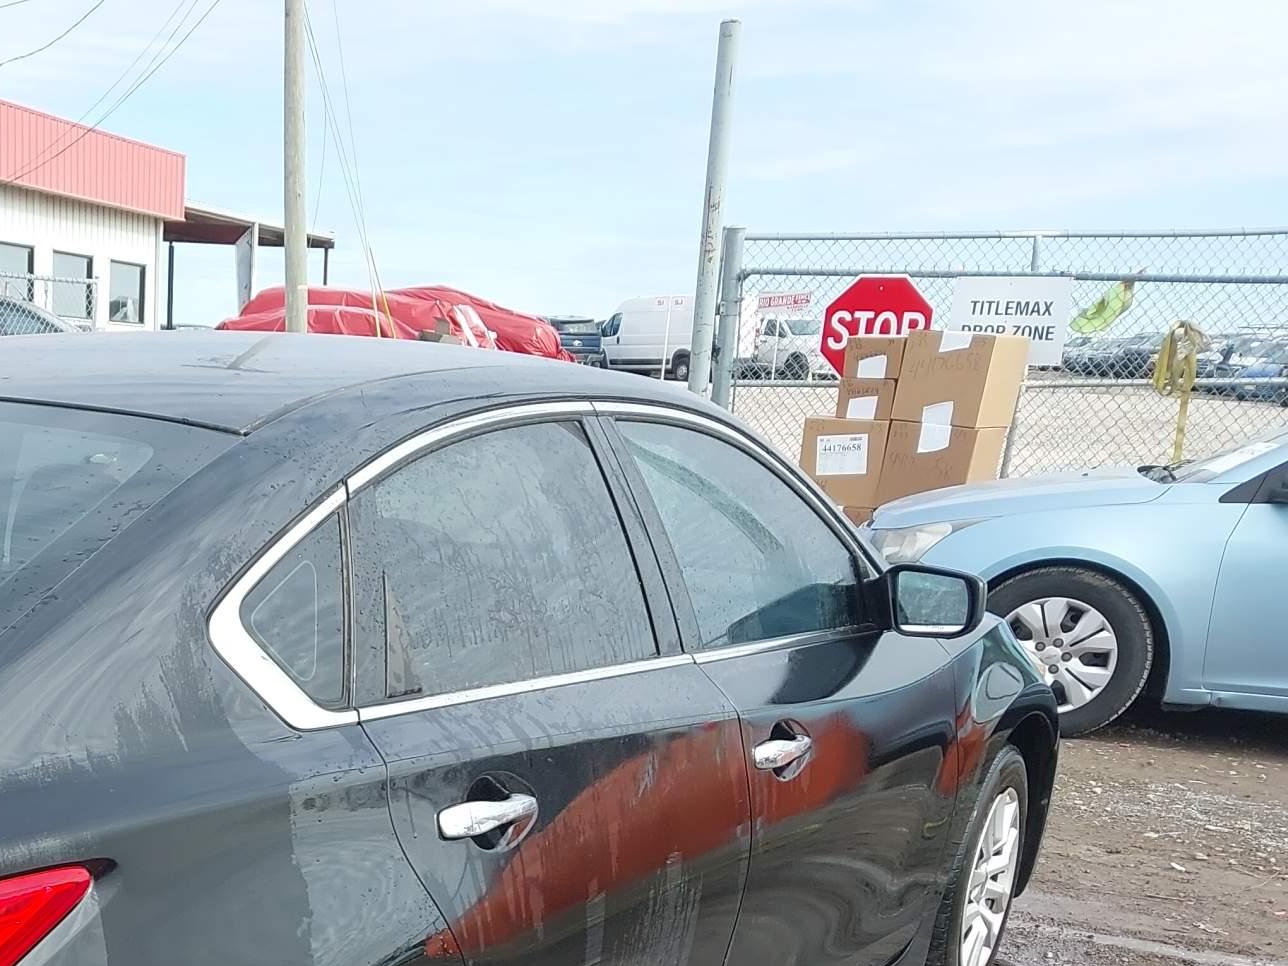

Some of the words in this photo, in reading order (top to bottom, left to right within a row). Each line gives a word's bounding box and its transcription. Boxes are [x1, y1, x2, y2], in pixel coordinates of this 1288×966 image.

[970, 300, 1054, 317] TITLEMAX
[1012, 325, 1057, 341] ZONE
[821, 443, 862, 453] 44176658
